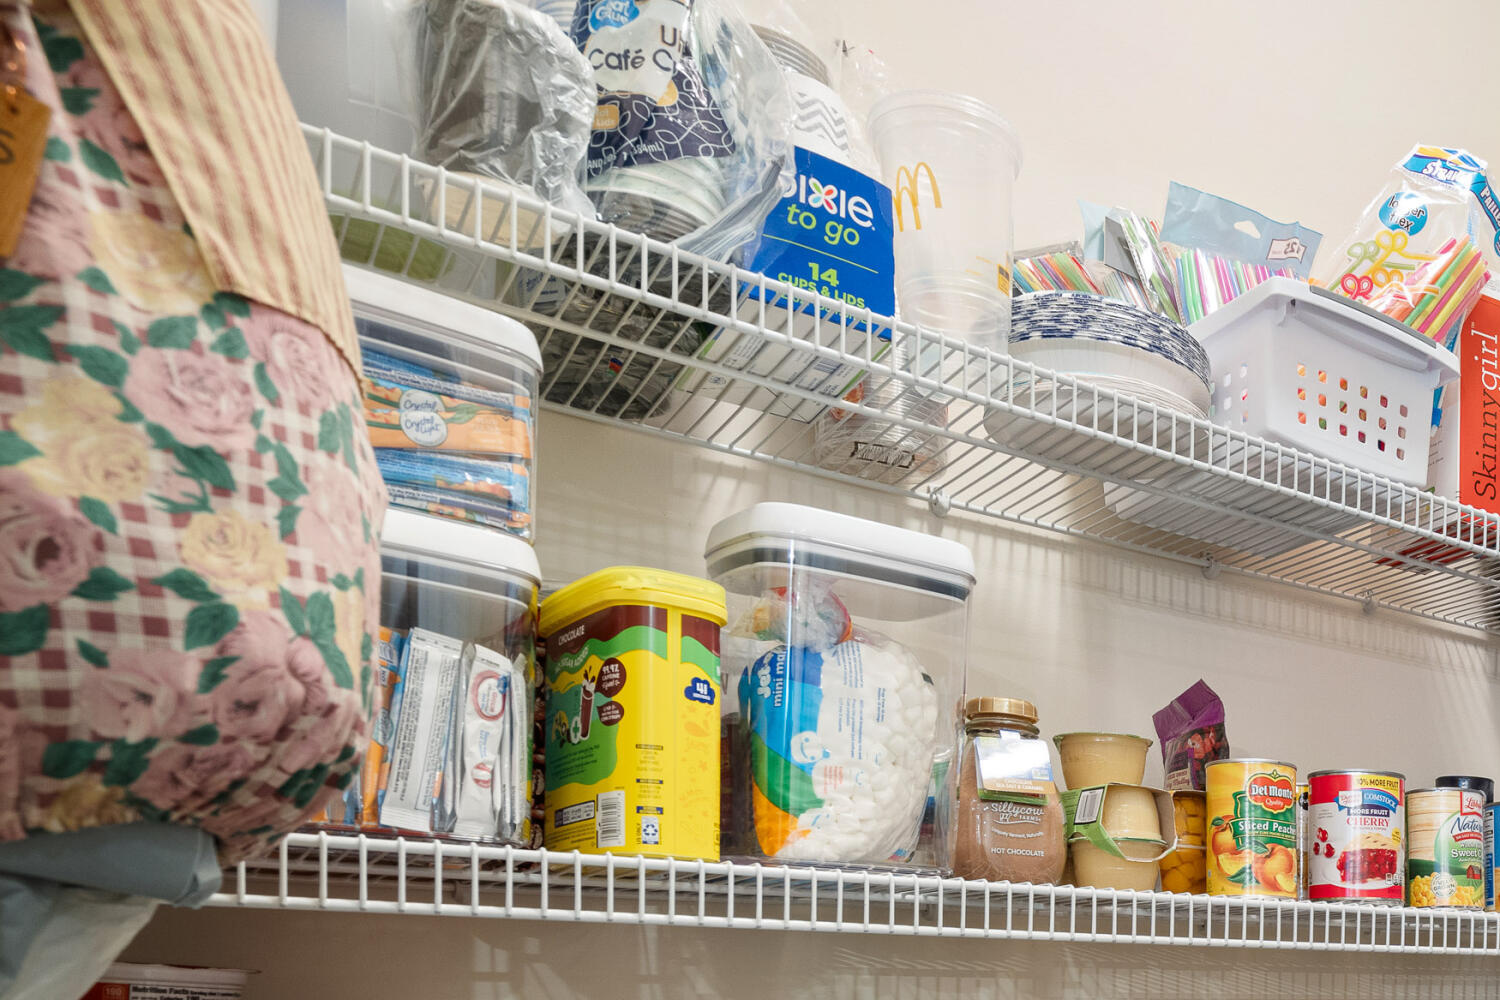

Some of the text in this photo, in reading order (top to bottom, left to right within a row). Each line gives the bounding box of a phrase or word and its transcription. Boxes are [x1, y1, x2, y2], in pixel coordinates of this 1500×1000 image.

[787, 204, 860, 246] to go
[808, 262, 839, 286] 14
[778, 272, 865, 308] CUPS LIDS
[558, 624, 585, 646] CHOCOLATE
[774, 677, 784, 707] mini
[1369, 778, 1399, 789] MORE FRUIT
[1251, 784, 1293, 800] Del Monte
[1363, 792, 1397, 809] COMSTOCK
[1346, 816, 1390, 828] CHERRY
[991, 847, 1045, 857] HOT CHOCOLATE
[1451, 848, 1477, 858] Sweet
[169, 987, 188, 996] Facts
